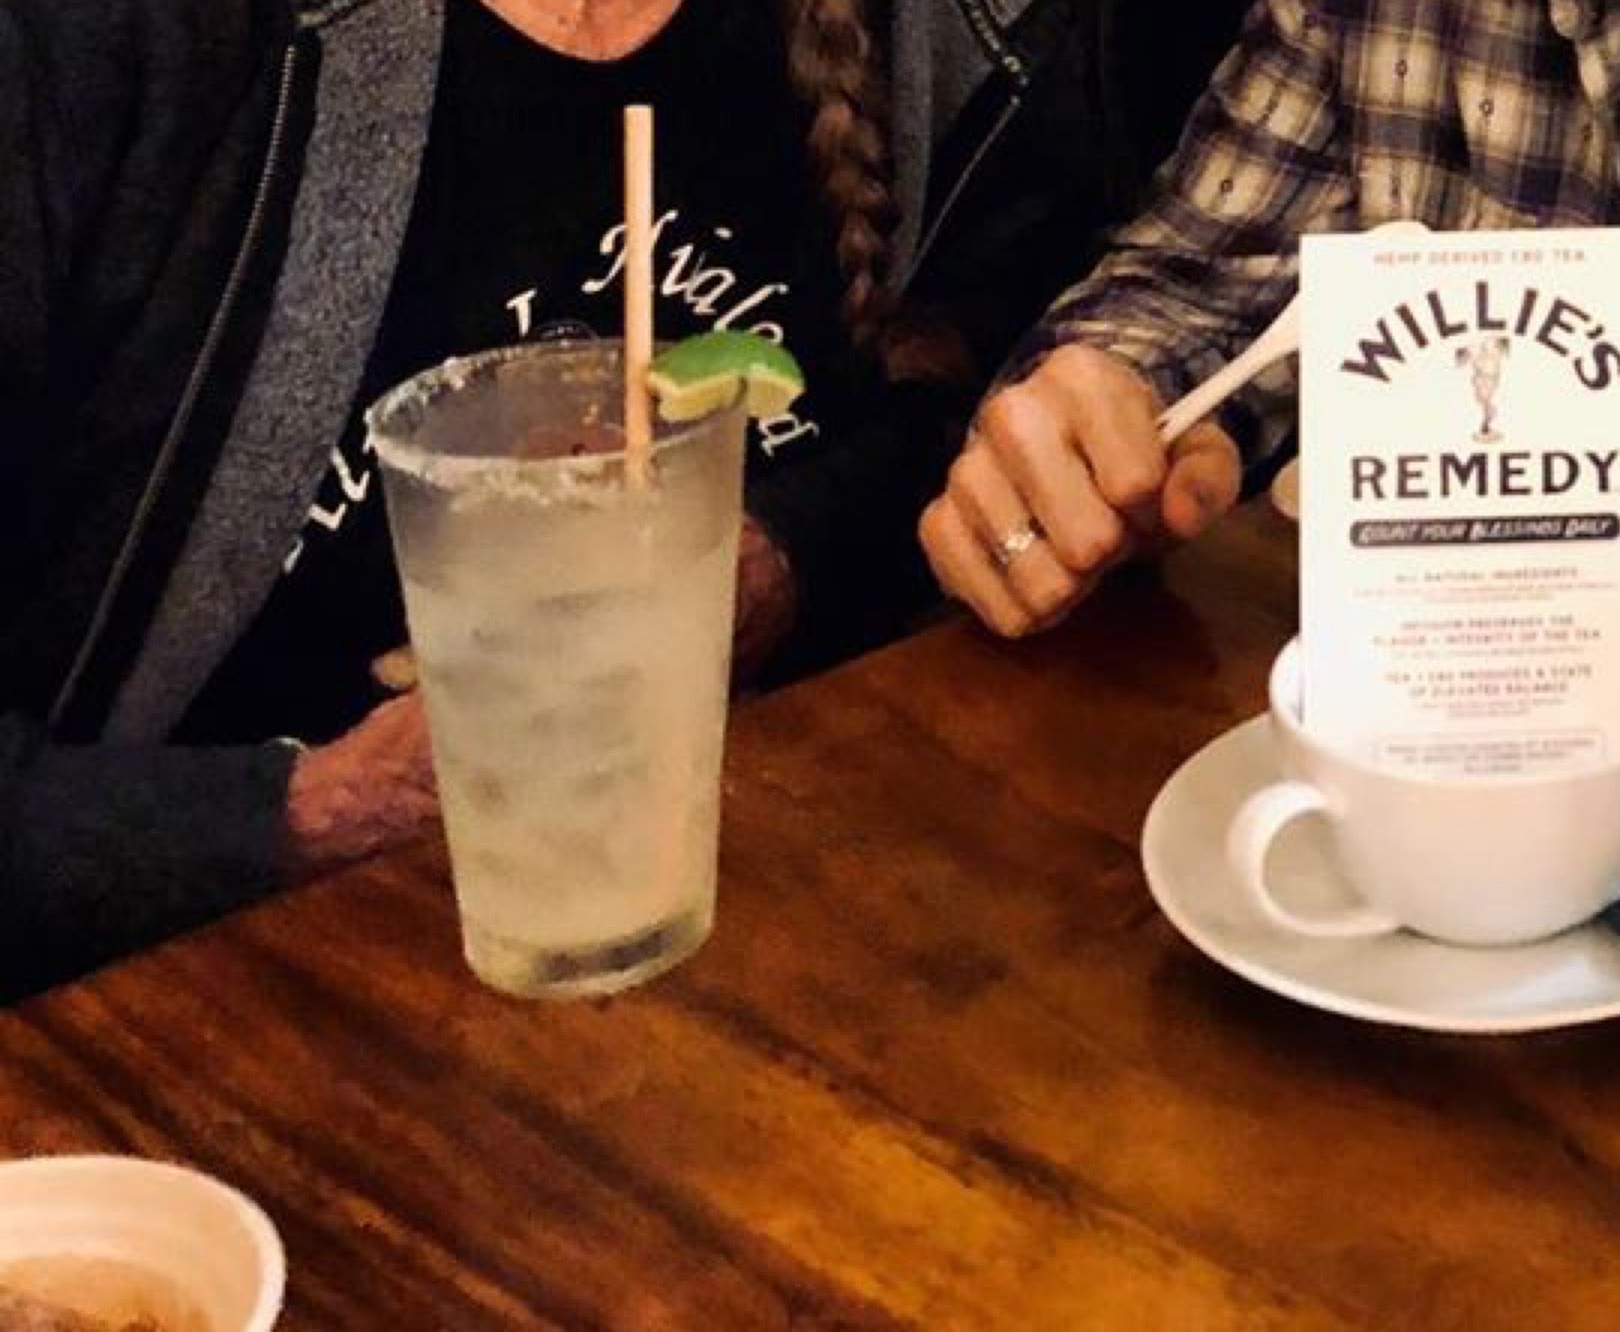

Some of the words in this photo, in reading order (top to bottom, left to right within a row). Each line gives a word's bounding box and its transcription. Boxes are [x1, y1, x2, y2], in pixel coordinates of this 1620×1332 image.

[1373, 252, 1421, 265] HEMP
[1429, 251, 1502, 264] DERIVED
[1511, 250, 1544, 263] CBD
[1552, 249, 1585, 262] TEA
[1350, 449, 1620, 500] REMEDY
